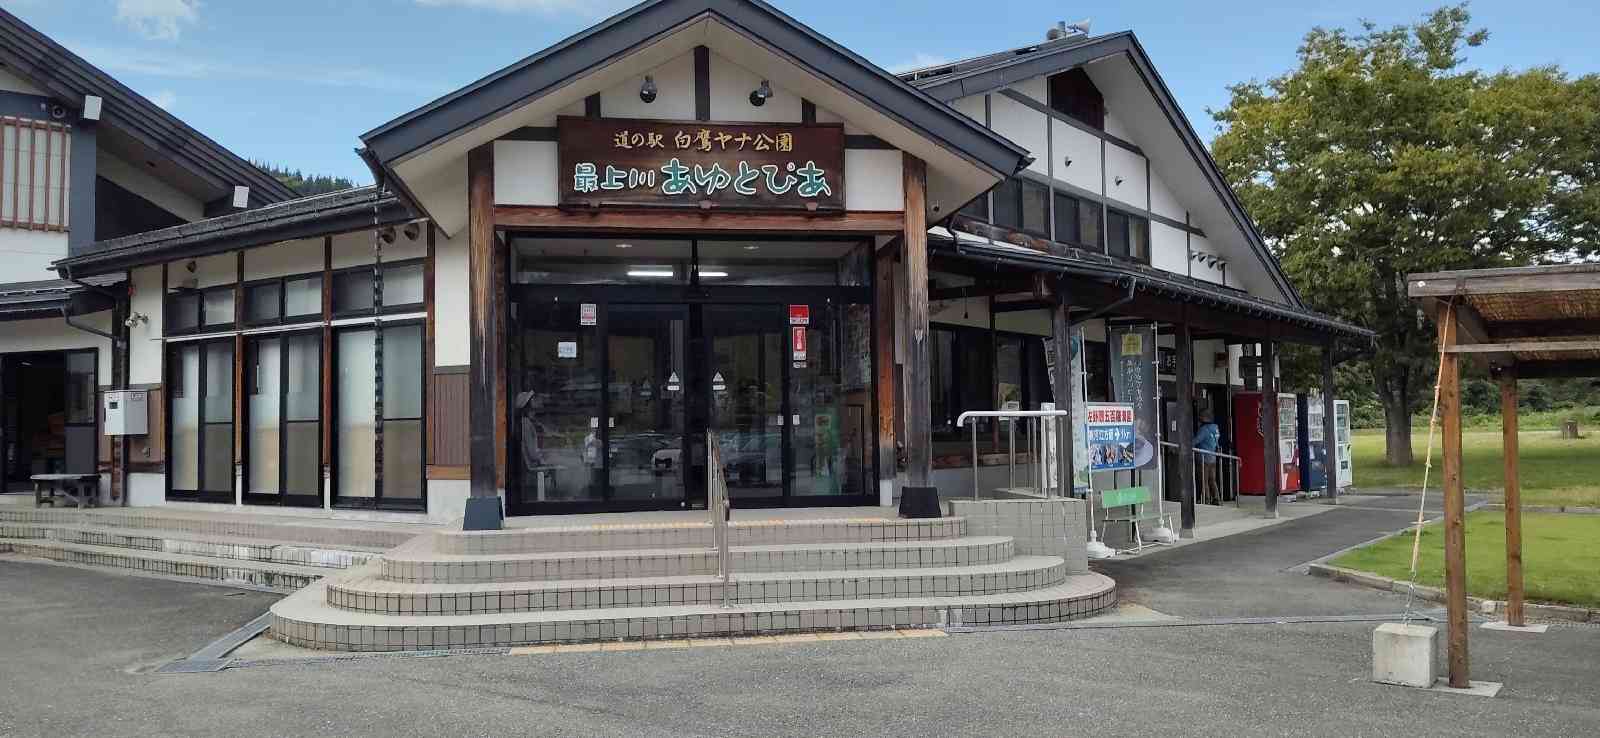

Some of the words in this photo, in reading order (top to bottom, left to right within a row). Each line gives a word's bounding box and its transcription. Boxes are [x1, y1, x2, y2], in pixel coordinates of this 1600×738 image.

[614, 131, 664, 149] 道の駅
[675, 128, 793, 152] 白鷹ヤナ公園
[574, 163, 655, 193] 最上川
[661, 158, 831, 197] あゆとぴあ
